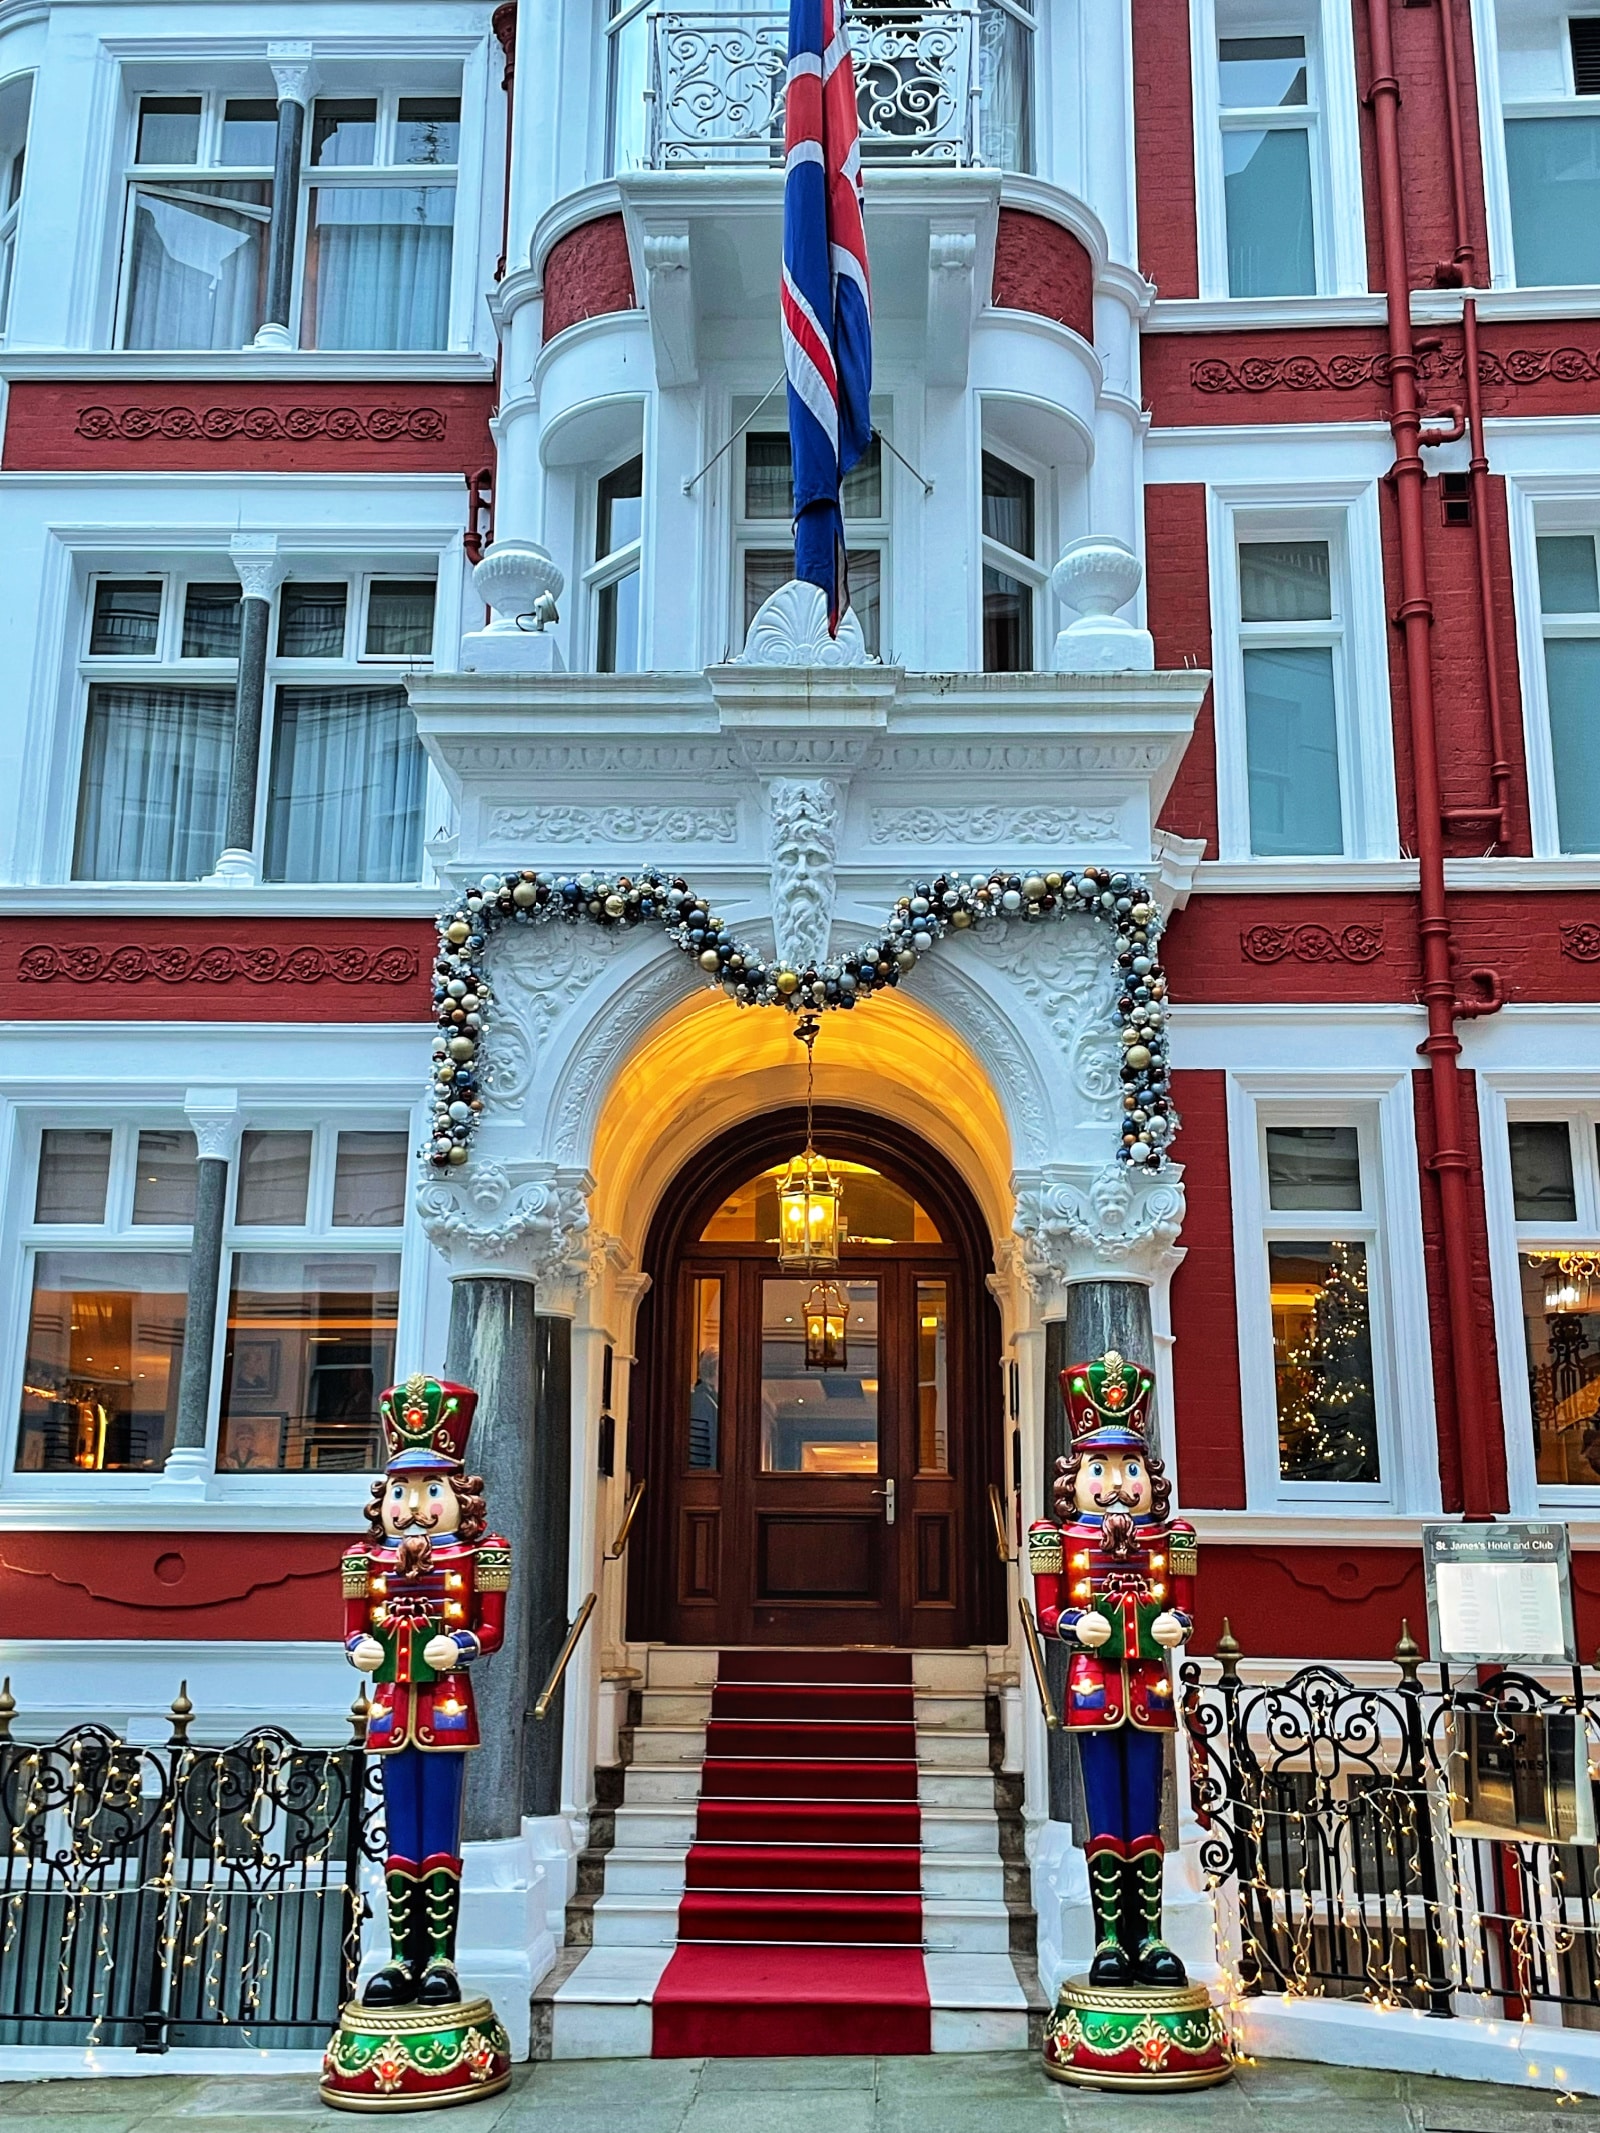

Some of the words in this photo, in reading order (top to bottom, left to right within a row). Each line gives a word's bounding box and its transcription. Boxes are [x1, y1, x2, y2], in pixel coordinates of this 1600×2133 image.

[1450, 1541, 1486, 1551] James's
[1488, 1541, 1510, 1550] Hotel
[1513, 1541, 1530, 1550] and
[1532, 1540, 1553, 1550] Club
